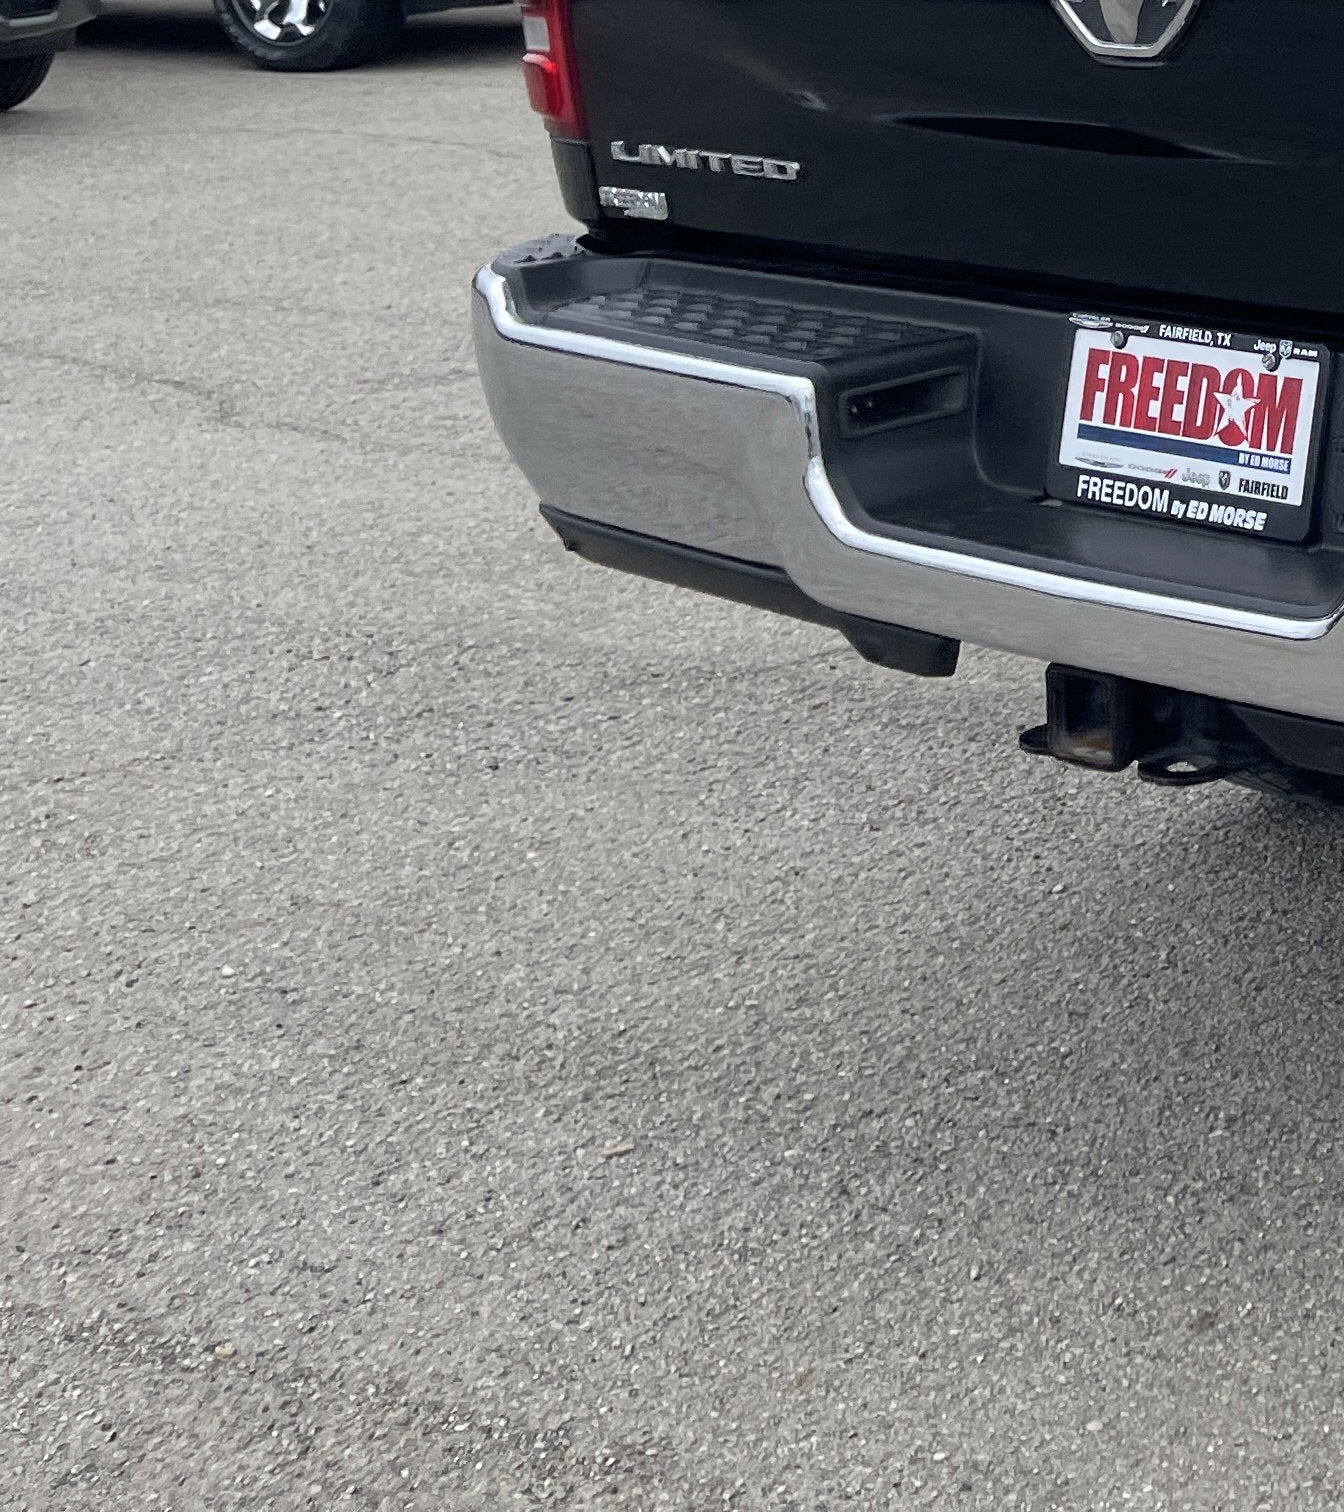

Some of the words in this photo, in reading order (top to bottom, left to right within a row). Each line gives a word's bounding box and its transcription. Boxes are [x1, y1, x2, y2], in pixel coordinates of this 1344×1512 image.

[610, 140, 801, 182] LIMITED
[1159, 324, 1214, 347] FAIRFIELD,
[1216, 332, 1232, 347] TX
[1253, 339, 1277, 354] Jeep
[1292, 347, 1318, 358] RAM
[1079, 347, 1303, 455] FREEDOM
[1238, 452, 1250, 465] BY
[1249, 454, 1261, 467] ED
[1260, 456, 1290, 472] MORSE
[1181, 468, 1211, 488] Jeep
[1238, 477, 1289, 500] FAIRFIELD
[1076, 474, 1170, 513] FREEDOM
[1186, 500, 1209, 521] ED
[1208, 504, 1268, 531] MORSE
